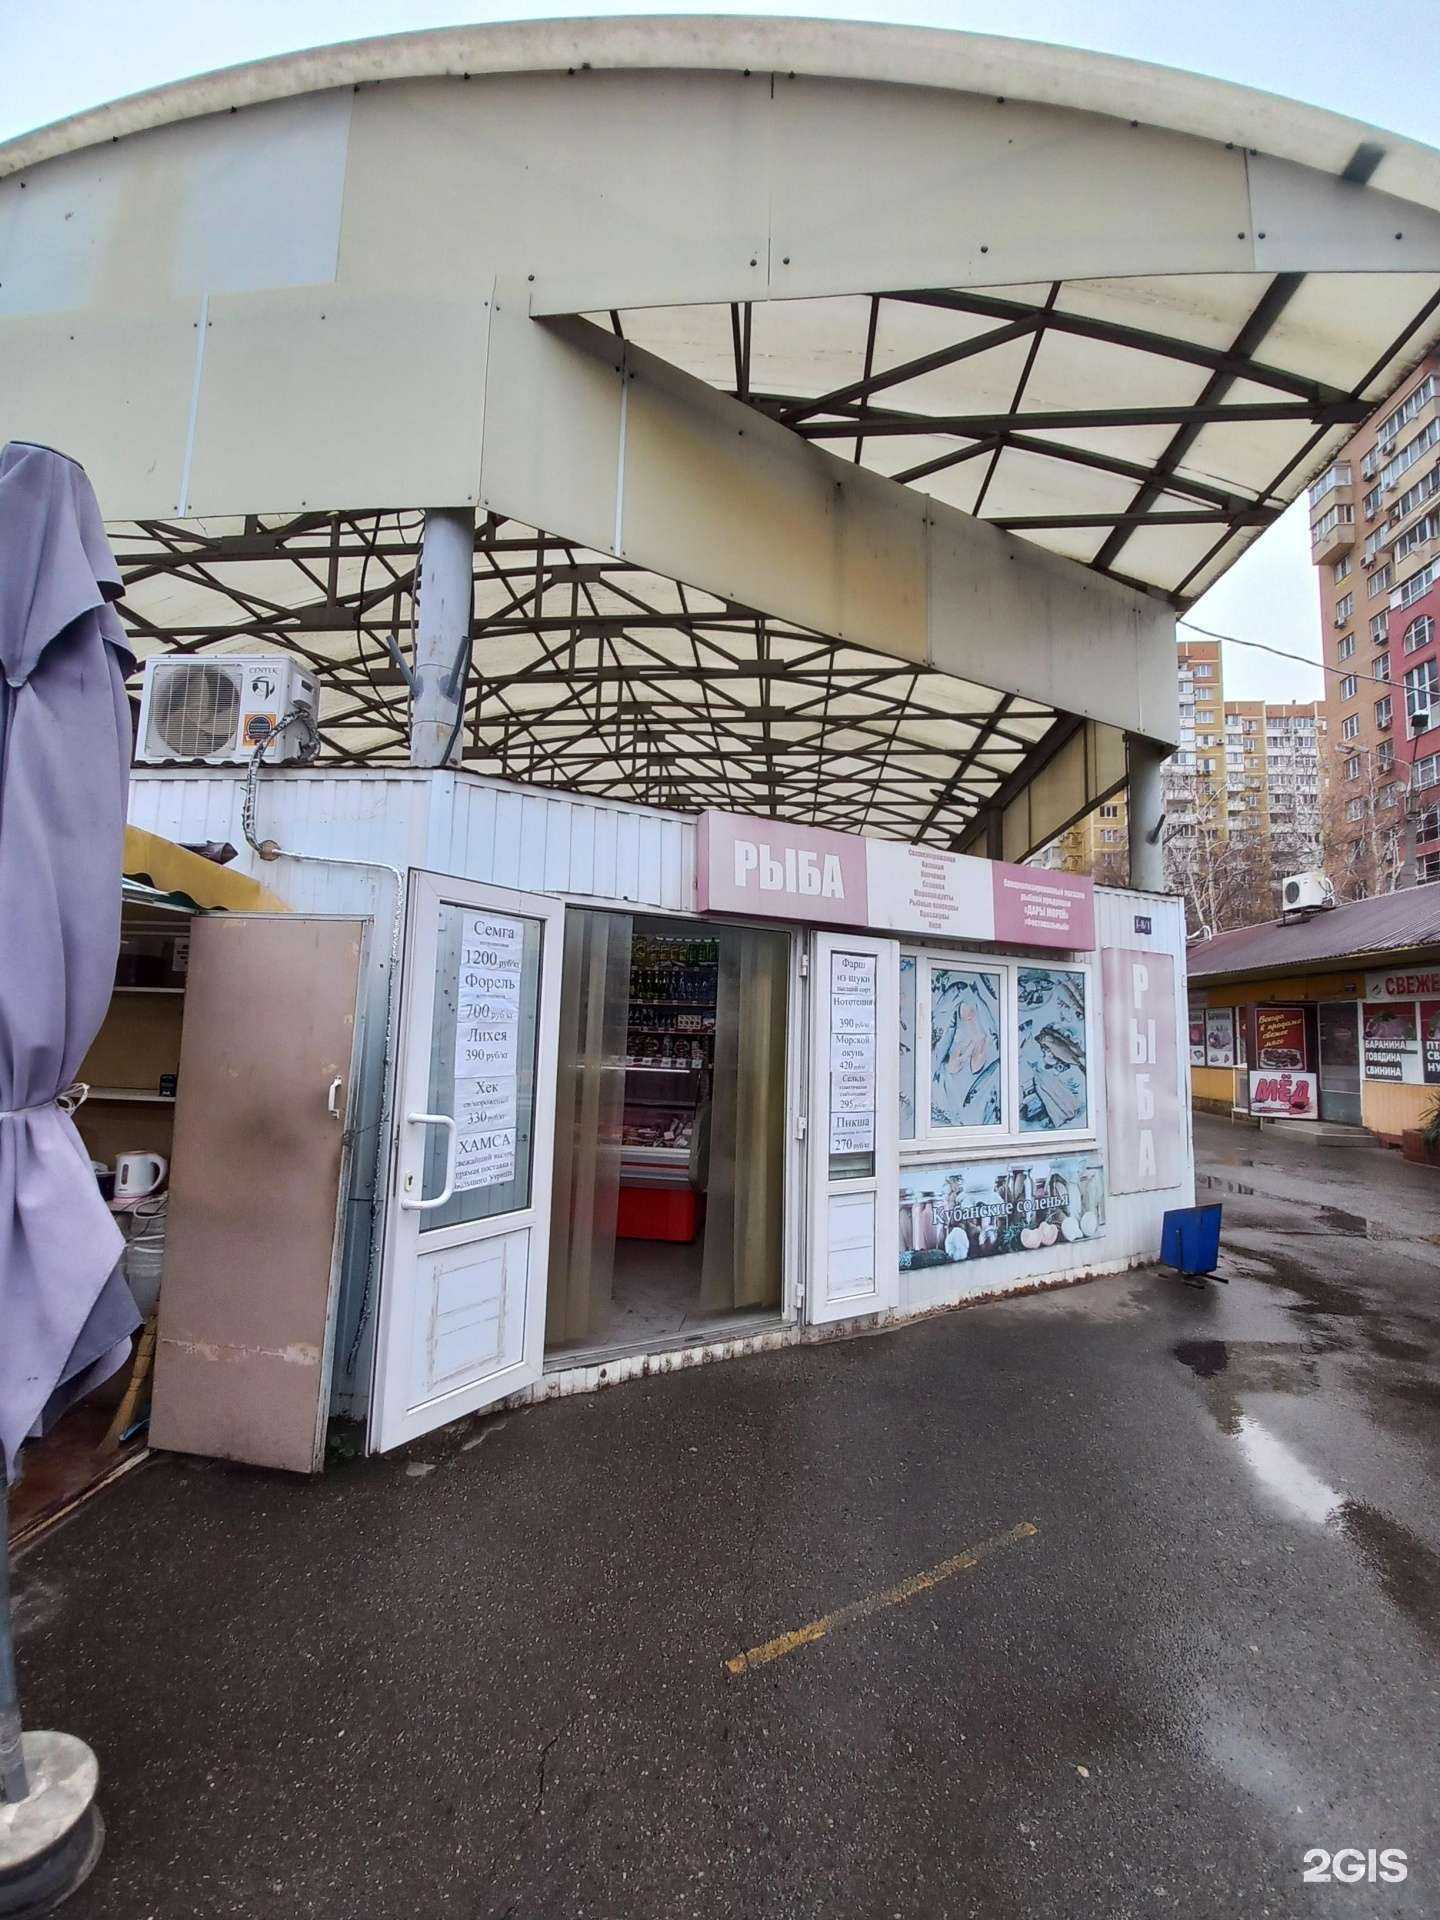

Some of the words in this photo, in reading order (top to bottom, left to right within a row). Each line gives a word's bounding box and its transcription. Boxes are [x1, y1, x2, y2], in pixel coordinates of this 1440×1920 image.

[734, 839, 846, 900] РЫБА
[473, 920, 515, 939] Семга
[466, 949, 498, 966] 1200
[842, 958, 866, 971] Фарш
[465, 973, 516, 992] Форель
[848, 974, 871, 984] щуки
[466, 1003, 490, 1018] 700
[839, 1017, 854, 1028] 390
[835, 1034, 870, 1046] Морской
[1365, 1040, 1406, 1049] БАРАНИНА
[465, 1049, 485, 1061] 390
[1365, 1051, 1401, 1062] ГОВЯДИНА
[1129, 963, 1157, 1177] РЫБА
[1366, 1065, 1402, 1077] СВИНИНА
[475, 1081, 499, 1095] Хек
[1255, 1074, 1310, 1106] МЁД
[467, 1111, 487, 1125] 330
[836, 1116, 870, 1129] Пикша
[459, 1133, 511, 1154] ХАМСА
[835, 1138, 853, 1151] 270
[932, 1202, 1014, 1226] Кубанские
[1016, 1194, 1070, 1212] соленья
